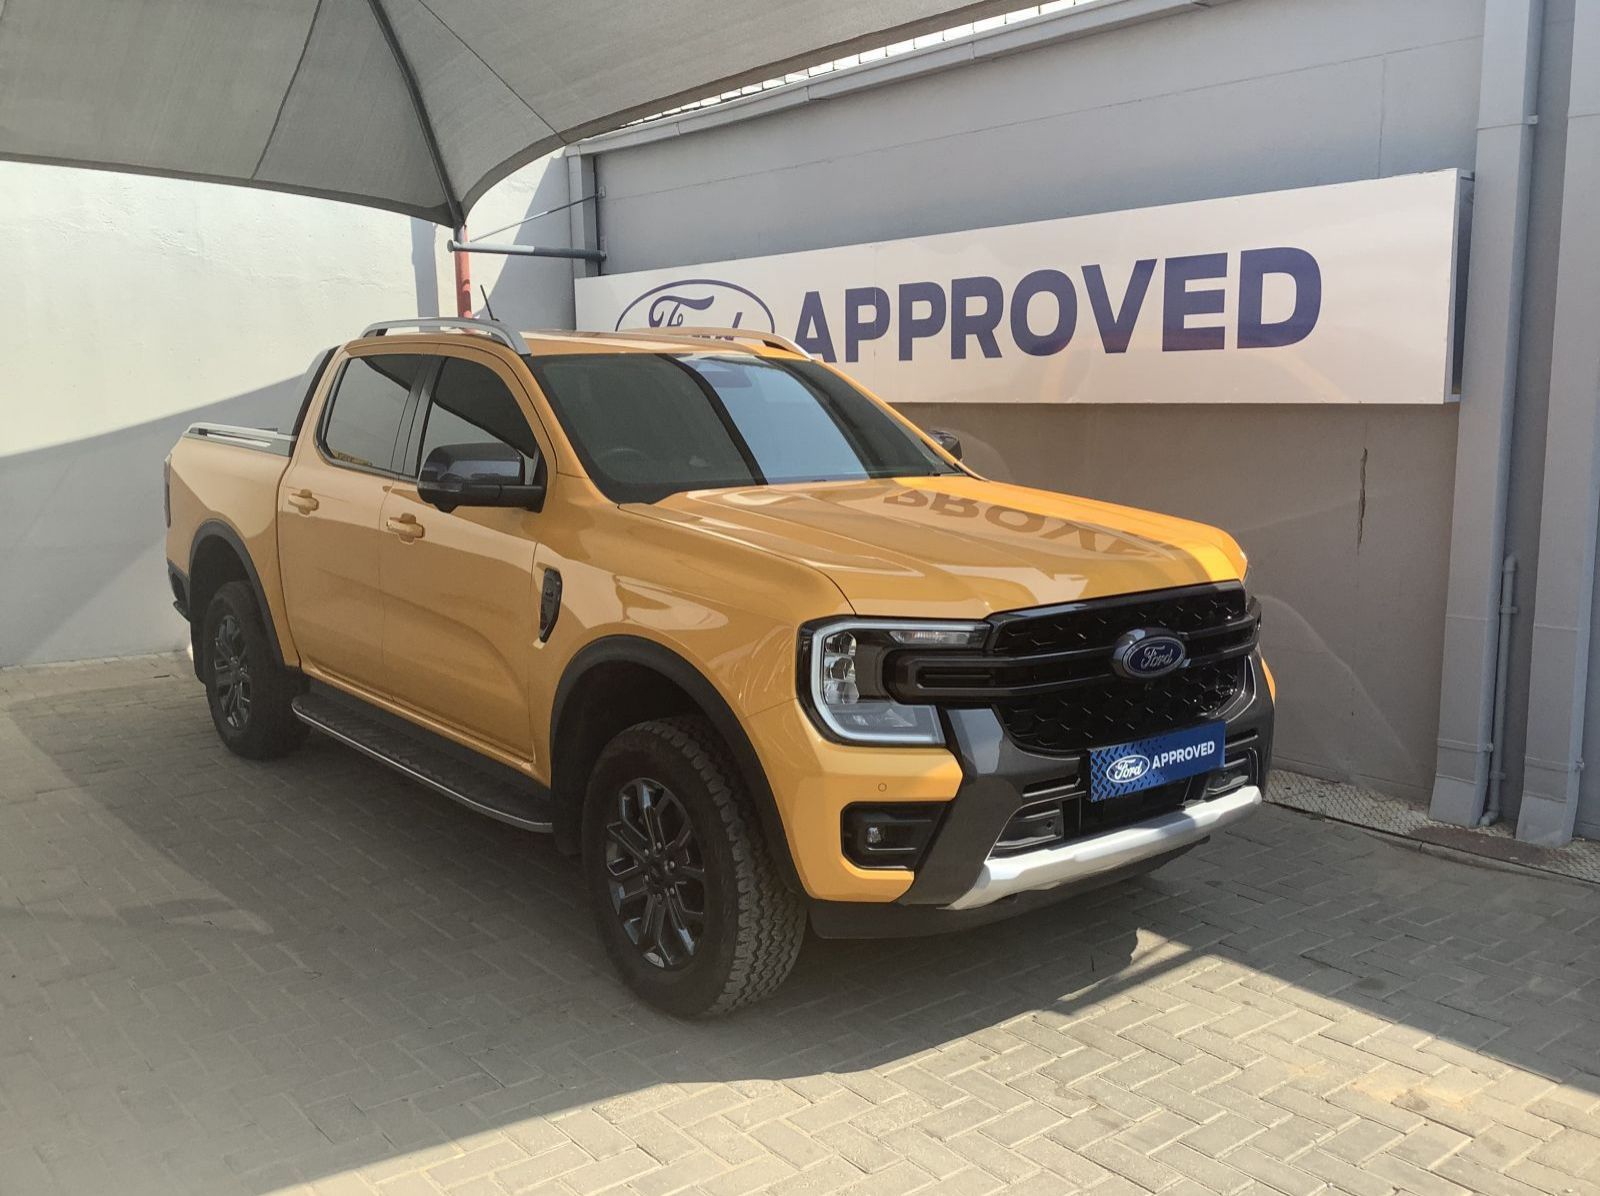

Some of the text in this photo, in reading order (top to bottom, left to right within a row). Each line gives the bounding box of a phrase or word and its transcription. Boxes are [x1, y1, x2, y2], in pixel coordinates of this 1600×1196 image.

[794, 246, 1322, 363] APPROVED
[1140, 645, 1174, 669] Ford
[1114, 740, 1216, 780] Ford APPROVED
